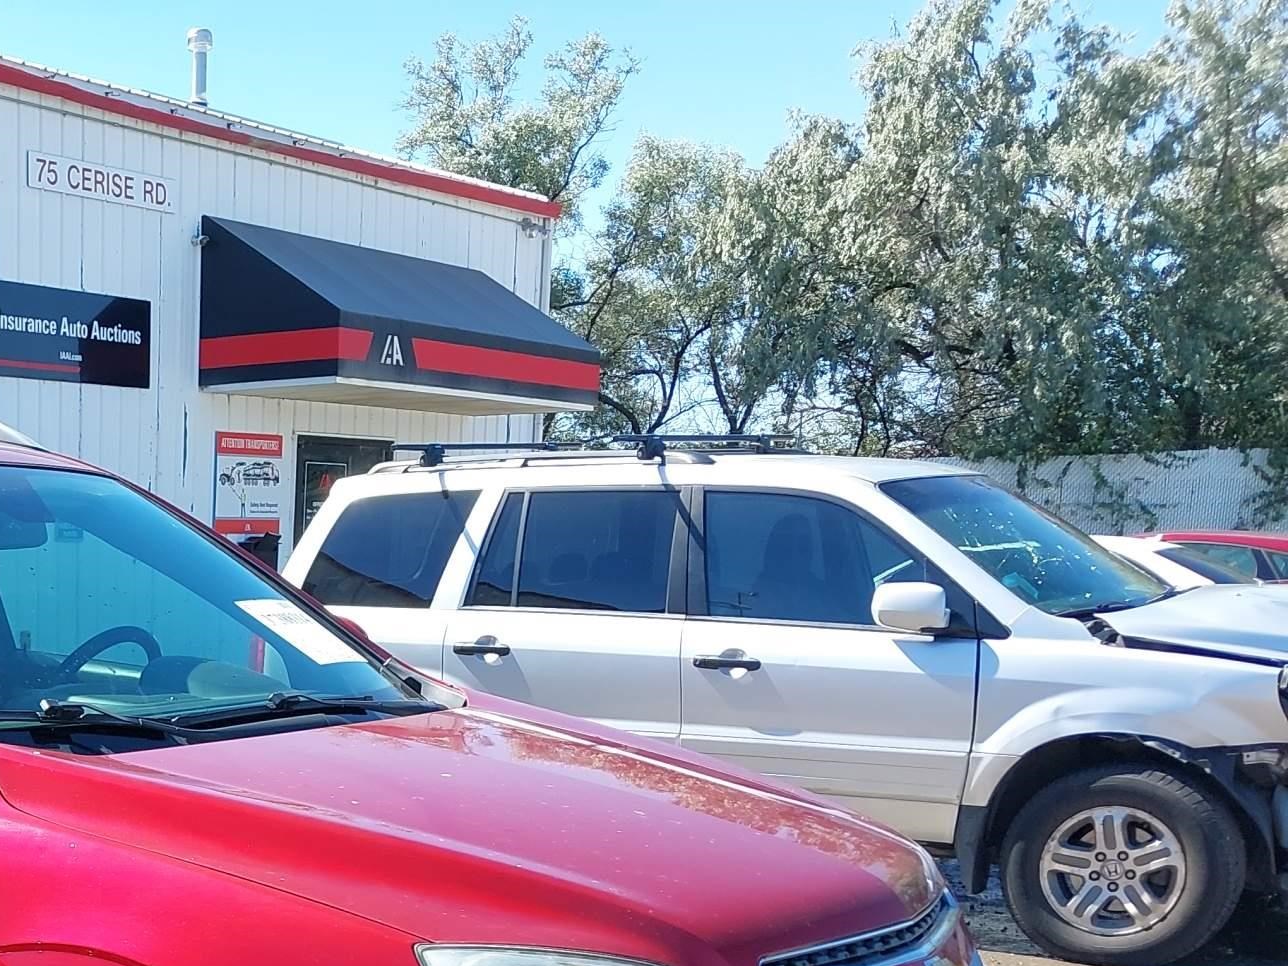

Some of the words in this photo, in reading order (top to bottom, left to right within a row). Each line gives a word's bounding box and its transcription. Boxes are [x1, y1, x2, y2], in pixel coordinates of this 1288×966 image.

[36, 158, 58, 186] 75
[67, 165, 135, 200] CERISE
[143, 179, 171, 206] RD.
[60, 316, 88, 340] Auto
[90, 320, 142, 345] Auctions
